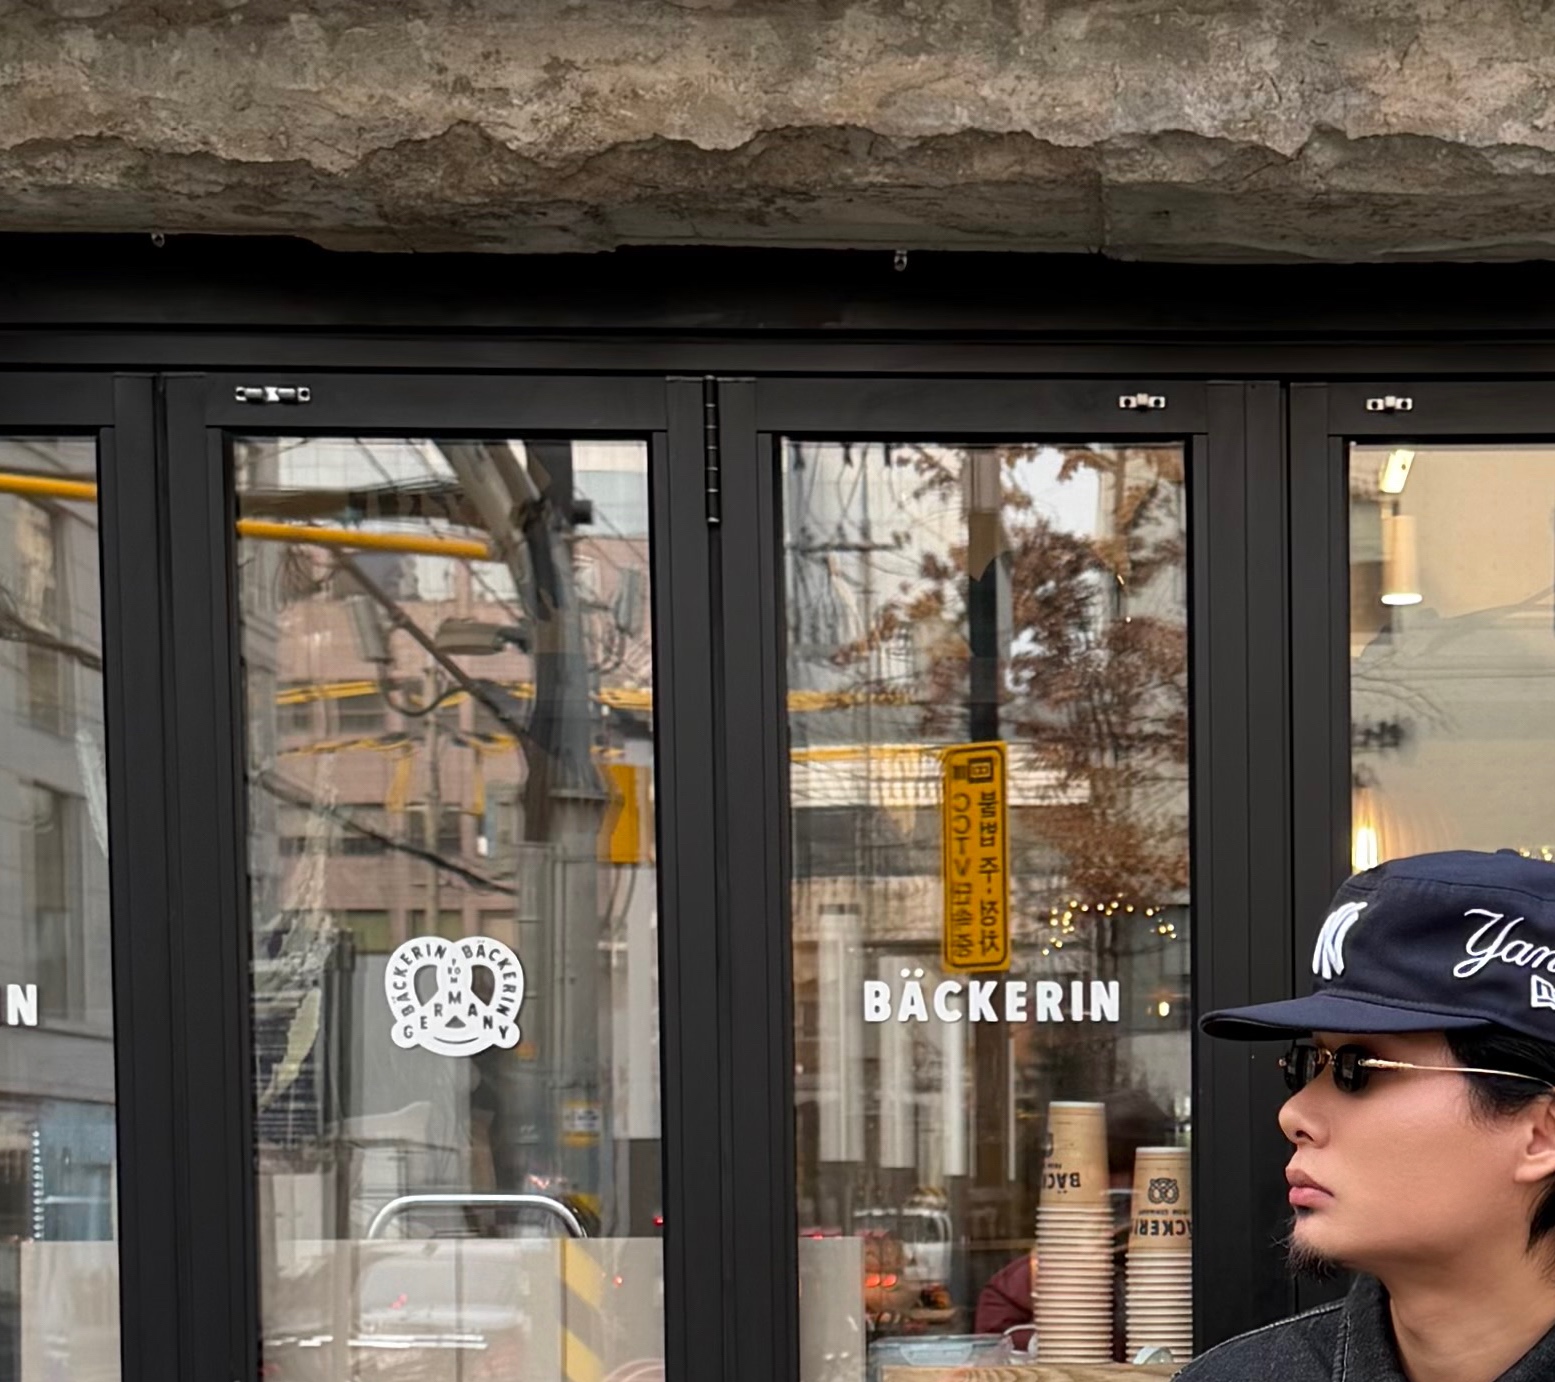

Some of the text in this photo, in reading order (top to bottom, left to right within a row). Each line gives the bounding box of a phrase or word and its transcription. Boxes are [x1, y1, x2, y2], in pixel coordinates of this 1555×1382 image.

[391, 943, 447, 1017] BÄCKERIN
[461, 939, 517, 1017] BÄCKERIN
[864, 968, 1120, 1022] BÄCKERIN
[403, 991, 509, 1040] GERMANY
